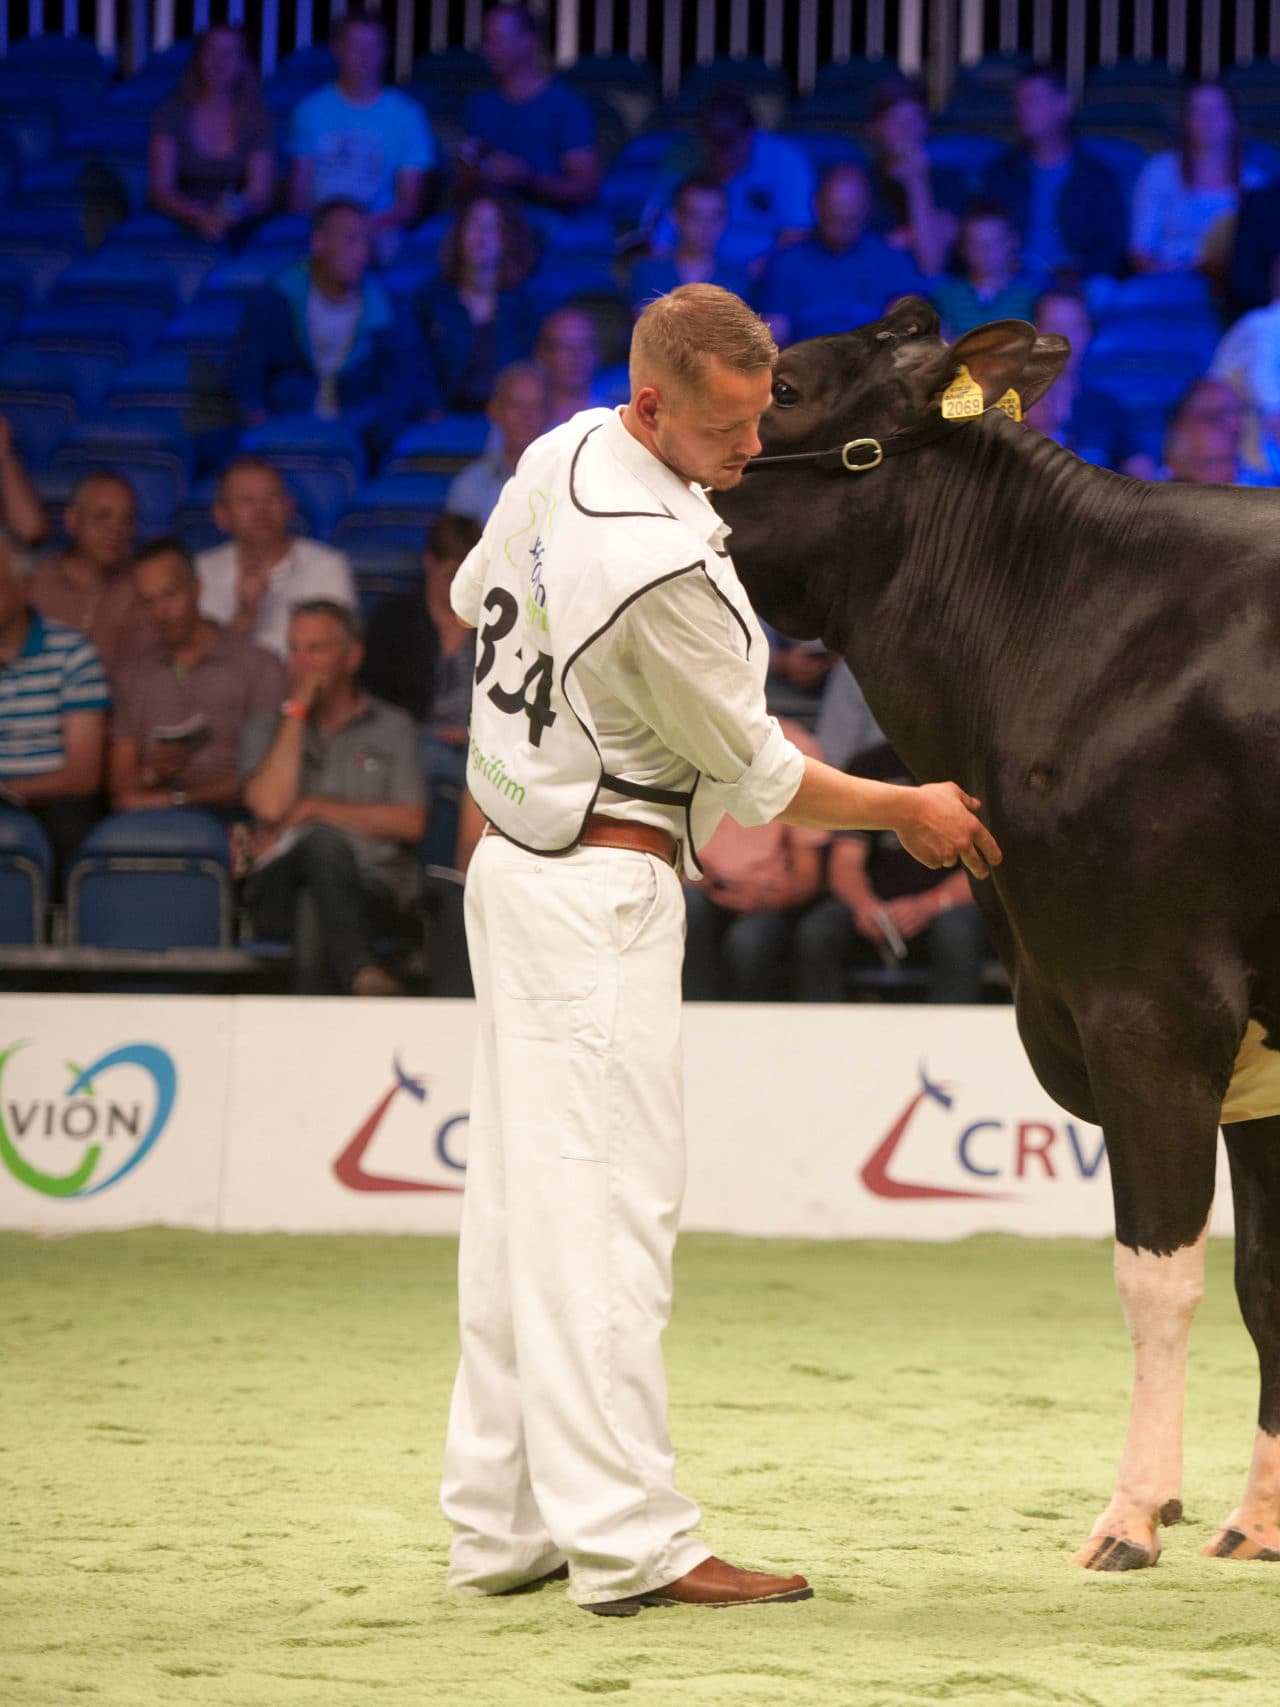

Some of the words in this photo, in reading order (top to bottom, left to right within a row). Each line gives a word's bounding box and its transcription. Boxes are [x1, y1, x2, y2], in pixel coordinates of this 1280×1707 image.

[947, 398, 980, 416] 2069
[8, 1102, 141, 1140] VION
[957, 1120, 1107, 1179] CRV
